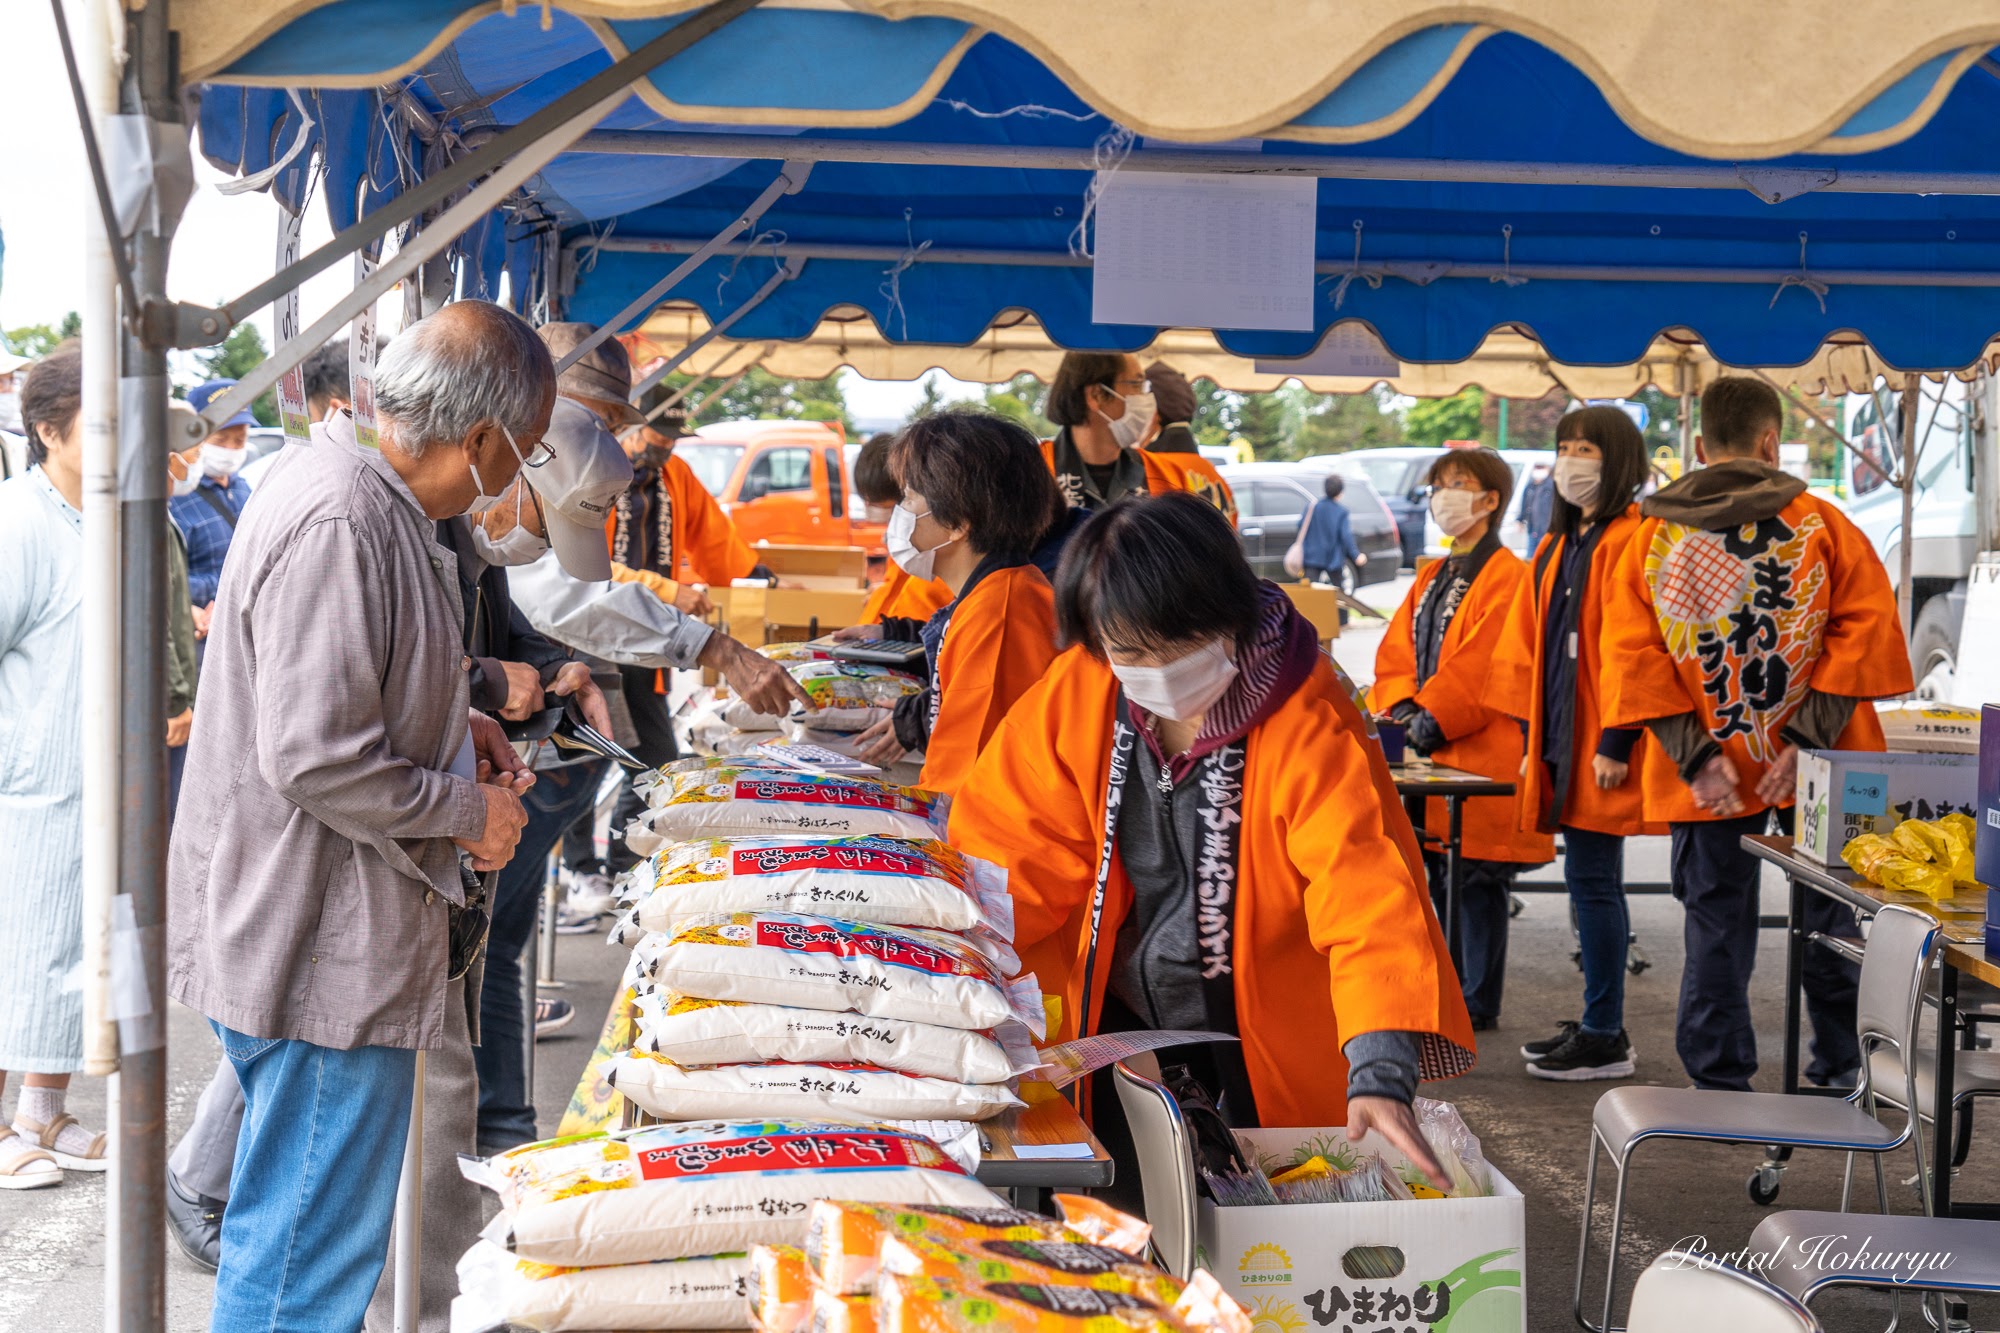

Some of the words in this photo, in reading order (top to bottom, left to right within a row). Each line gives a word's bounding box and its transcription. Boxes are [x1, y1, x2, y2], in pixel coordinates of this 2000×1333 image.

[1713, 516, 1797, 712] ひまわり
[1697, 631, 1754, 741] ライス
[810, 885, 870, 903] きたくりん
[838, 968, 893, 992] きたくりん
[836, 1020, 897, 1044] きたくりん
[799, 1076, 861, 1095] きたくりん
[757, 1196, 809, 1218] ななつ
[1240, 1272, 1293, 1283] ひまわりの里
[1303, 1280, 1452, 1327] ひまわり
